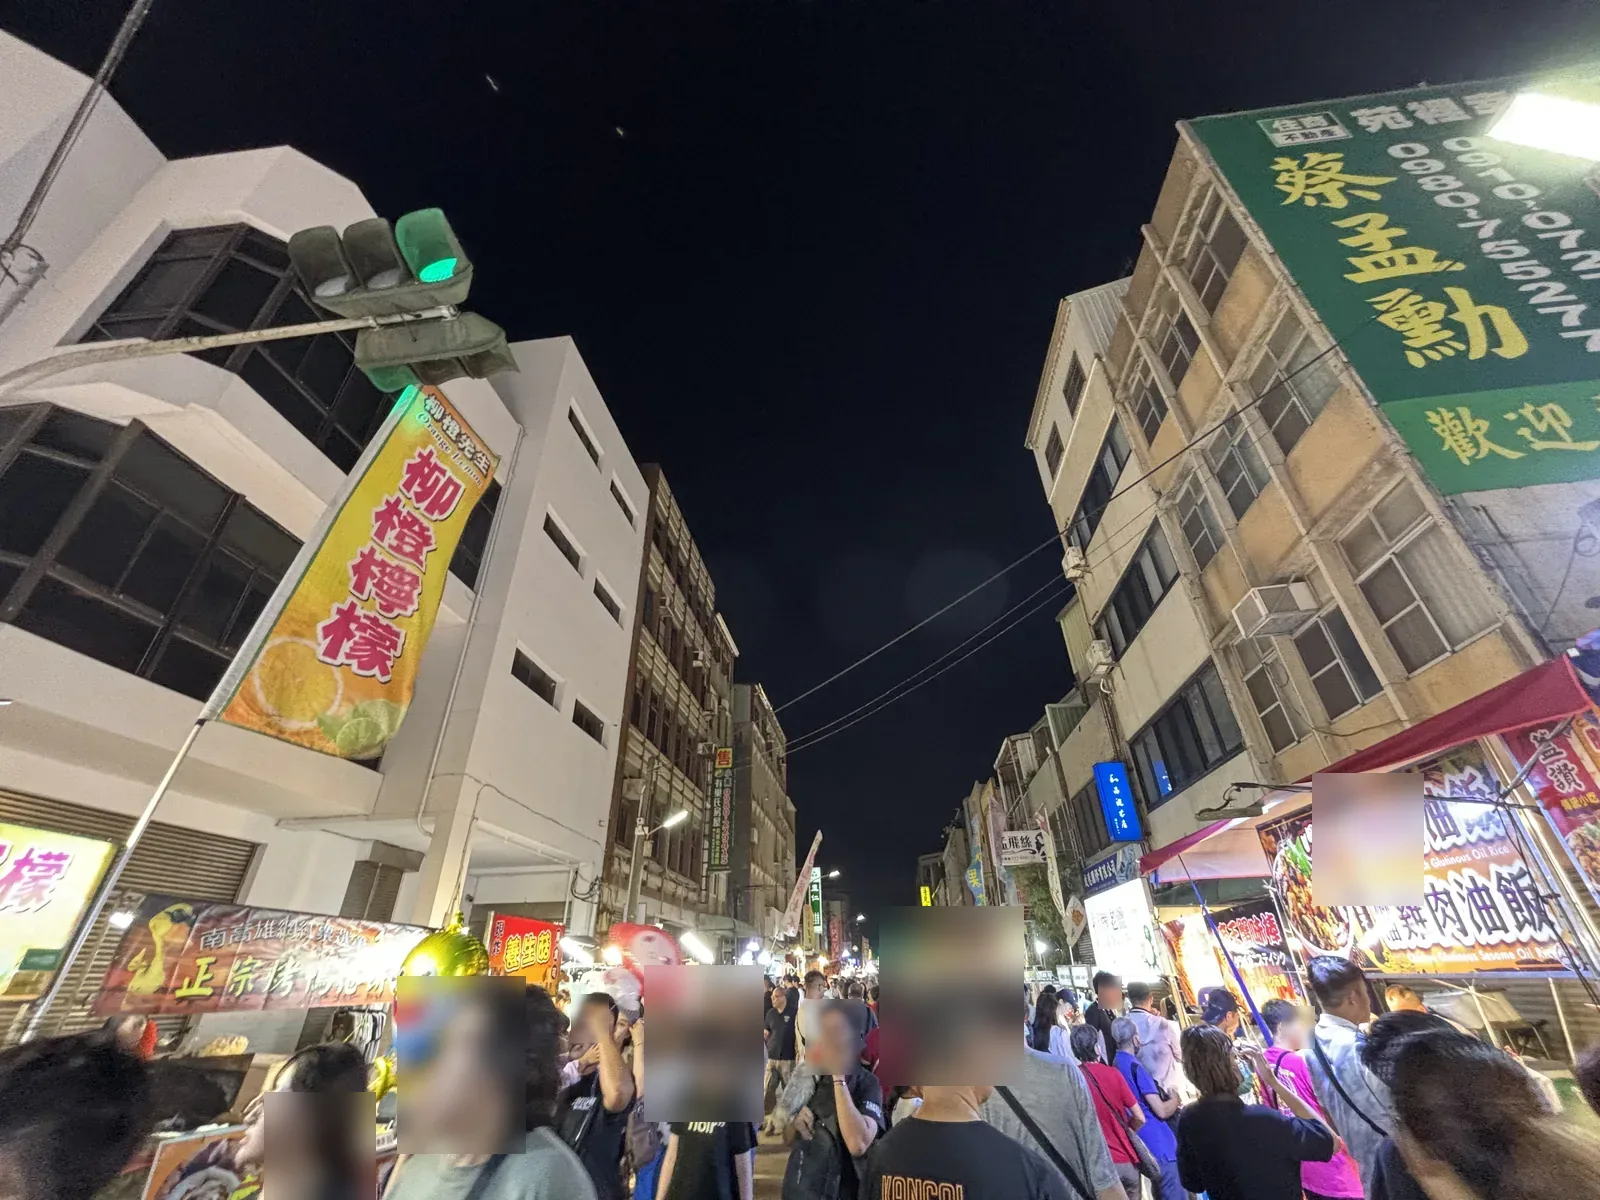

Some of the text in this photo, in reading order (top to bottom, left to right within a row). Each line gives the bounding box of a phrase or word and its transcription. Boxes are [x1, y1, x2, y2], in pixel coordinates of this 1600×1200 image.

[1443, 136, 1600, 281] 0910-072
[1270, 152, 1530, 368] 蔡孟勳
[424, 393, 490, 478] 柳橙先生
[1425, 395, 1600, 466] 歡迎
[317, 448, 466, 683] 柳橙檸檬
[0, 844, 72, 908] 檬
[1001, 834, 1033, 850] 飛絲
[1430, 852, 1471, 868] Glutinous
[1471, 846, 1486, 860] Oil
[1488, 844, 1510, 858] Rice
